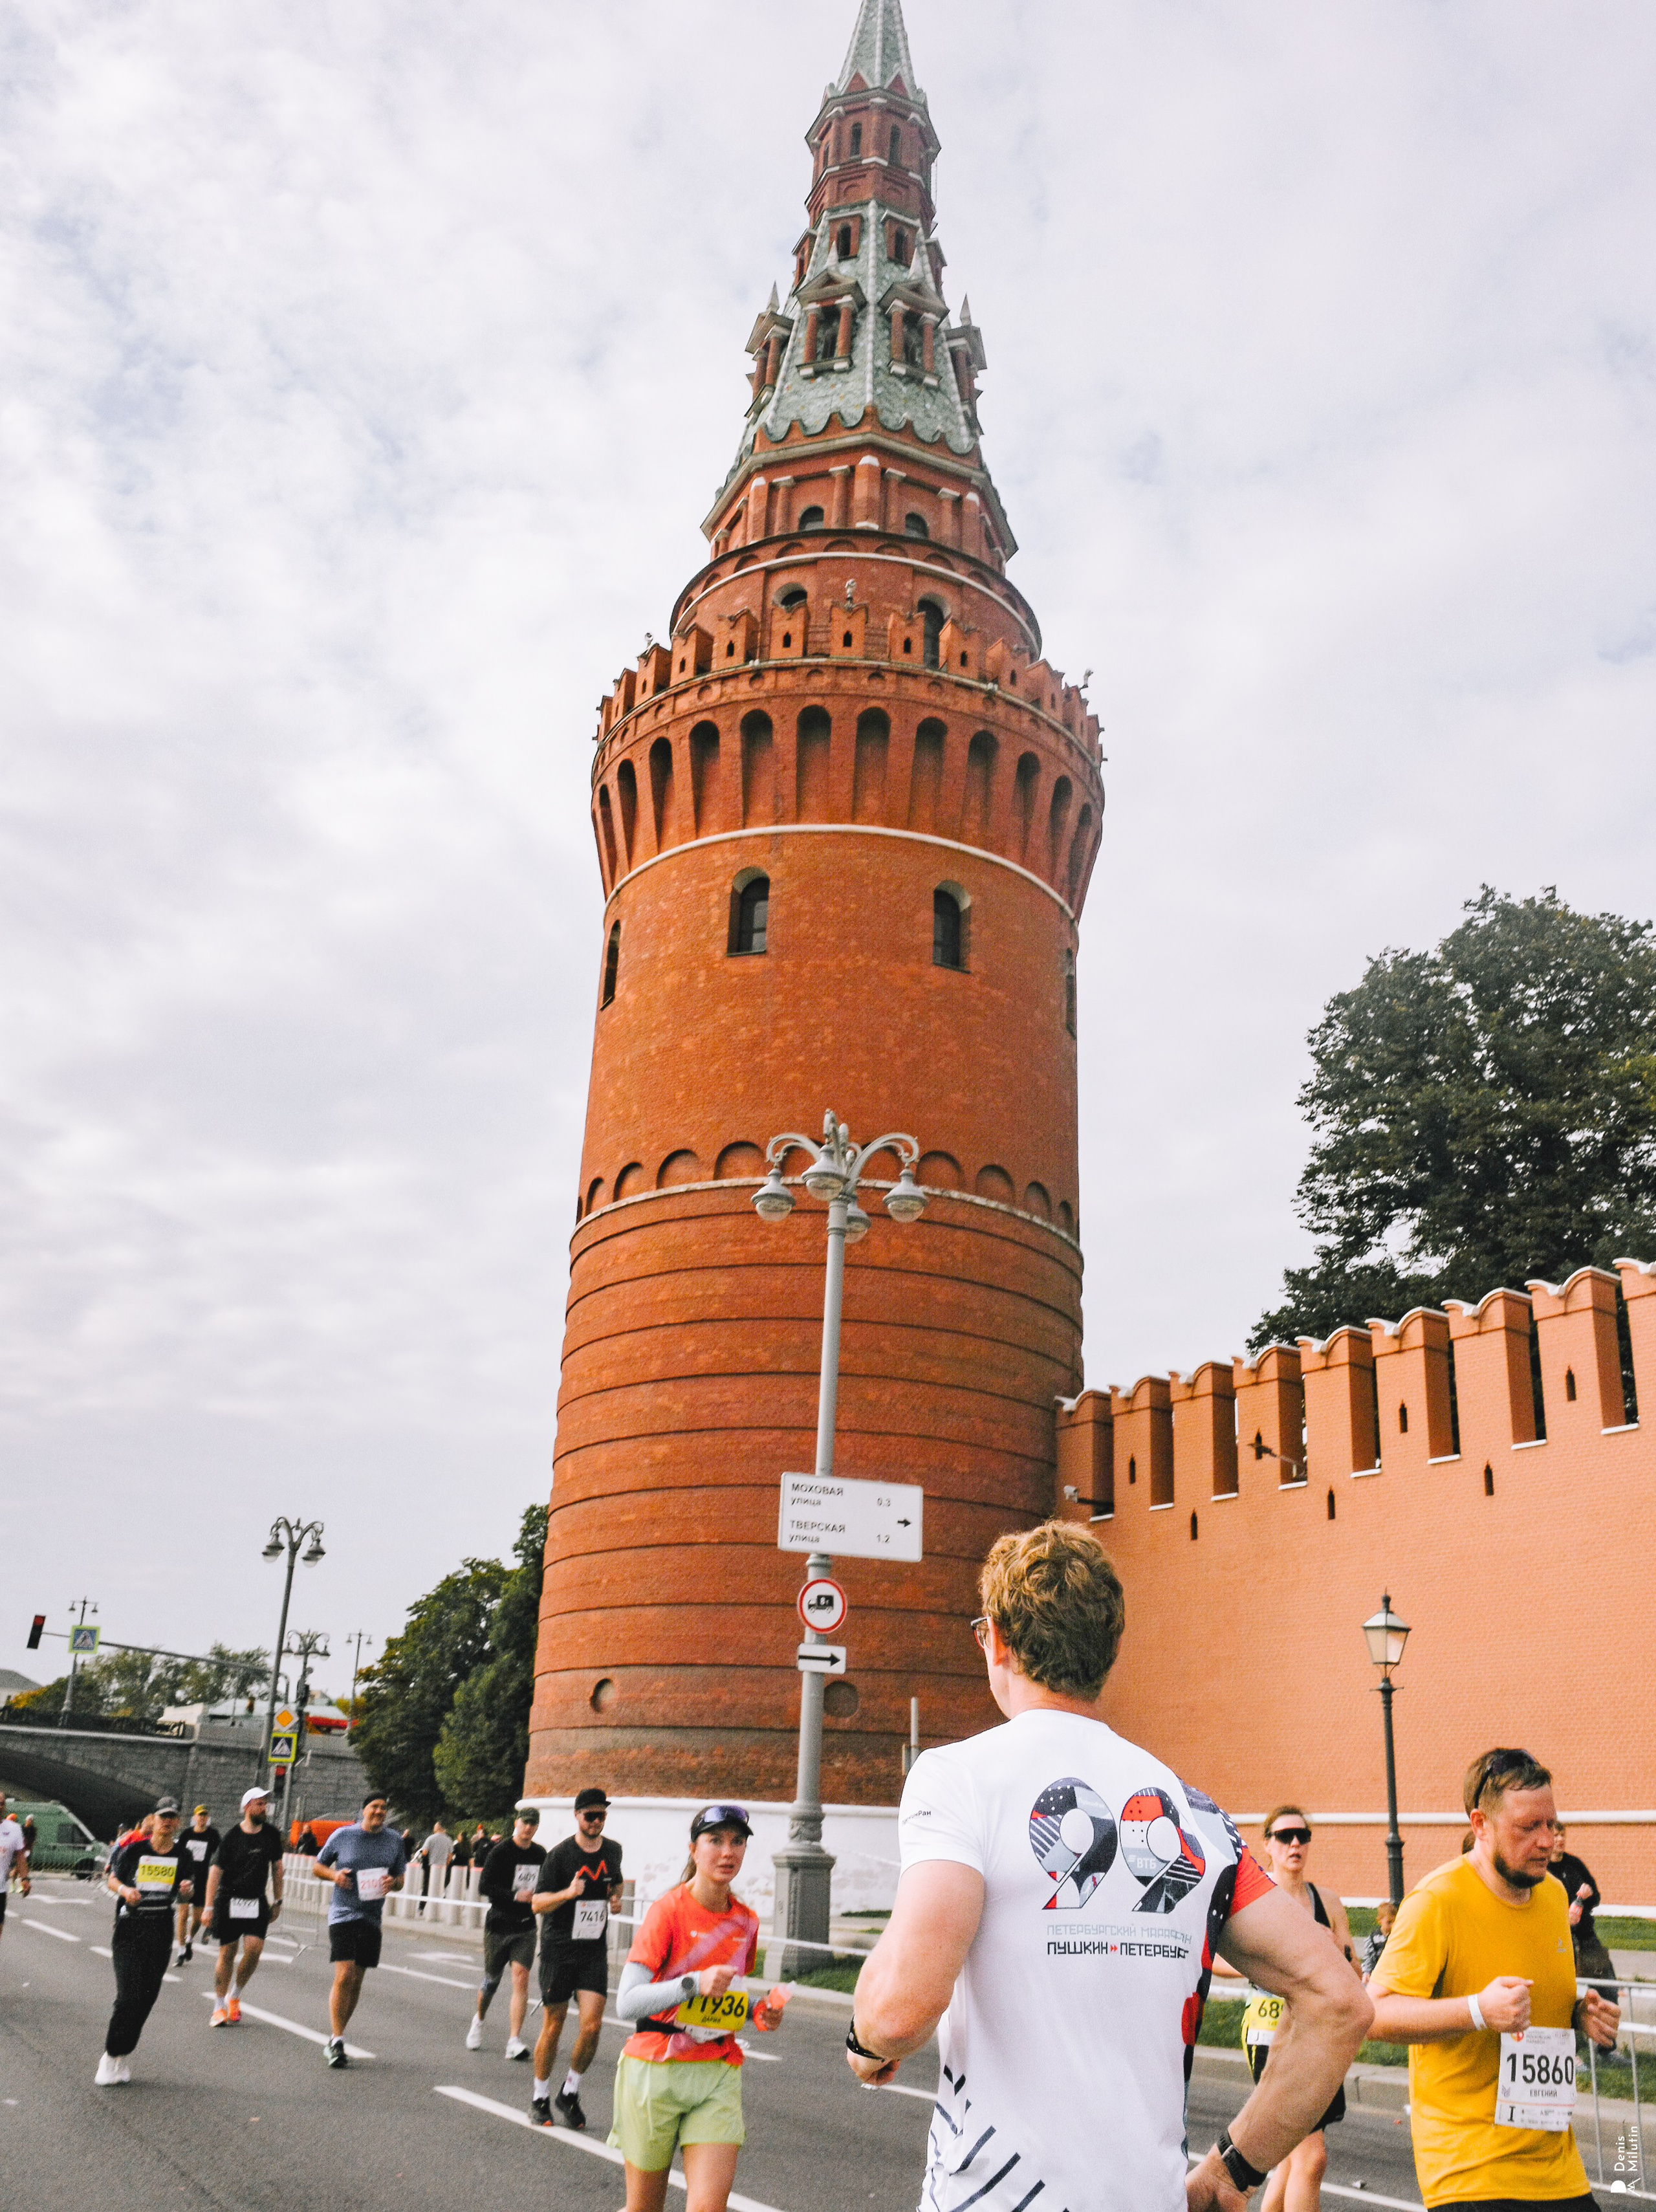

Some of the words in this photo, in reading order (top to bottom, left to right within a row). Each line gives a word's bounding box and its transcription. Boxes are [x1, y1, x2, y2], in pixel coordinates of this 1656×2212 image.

[791, 1483, 844, 1496] МОХОВАЯ
[791, 1497, 821, 1506] улица
[790, 1520, 845, 1533] ТВЕРСКАЯ
[789, 1534, 820, 1543] улица
[1137, 1857, 1157, 1869] ВТБ
[580, 1910, 606, 1923] 7416
[1047, 1923, 1136, 1937] ПЕТЕРБУРГСКИЙ
[1047, 1942, 1108, 1955] ПУШКИН
[1507, 2053, 1574, 2085] 15860
[1530, 2088, 1557, 2097] ЕВГЕНИЙ
